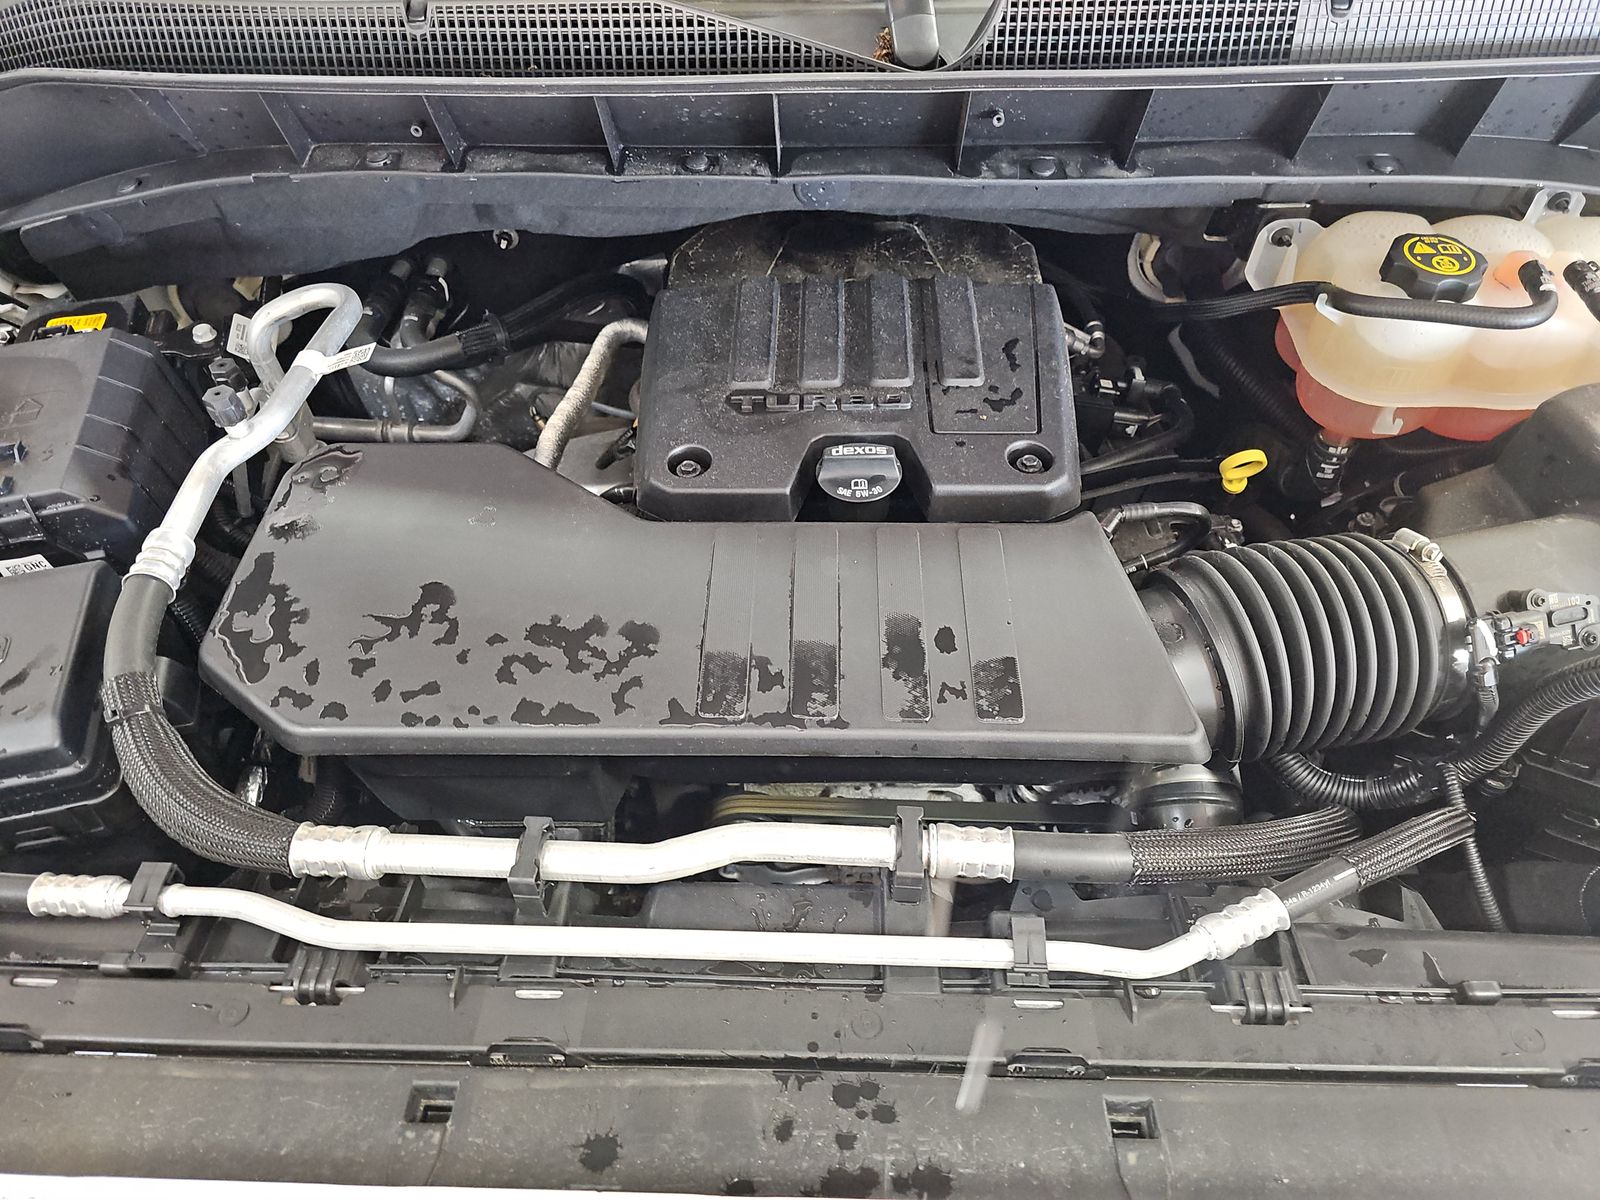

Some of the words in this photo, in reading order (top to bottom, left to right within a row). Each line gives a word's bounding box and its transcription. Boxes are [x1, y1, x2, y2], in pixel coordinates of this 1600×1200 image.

[730, 394, 912, 413] TURBO
[831, 445, 888, 456] dexos
[837, 486, 853, 497] SAE
[855, 485, 883, 498] 5W-30
